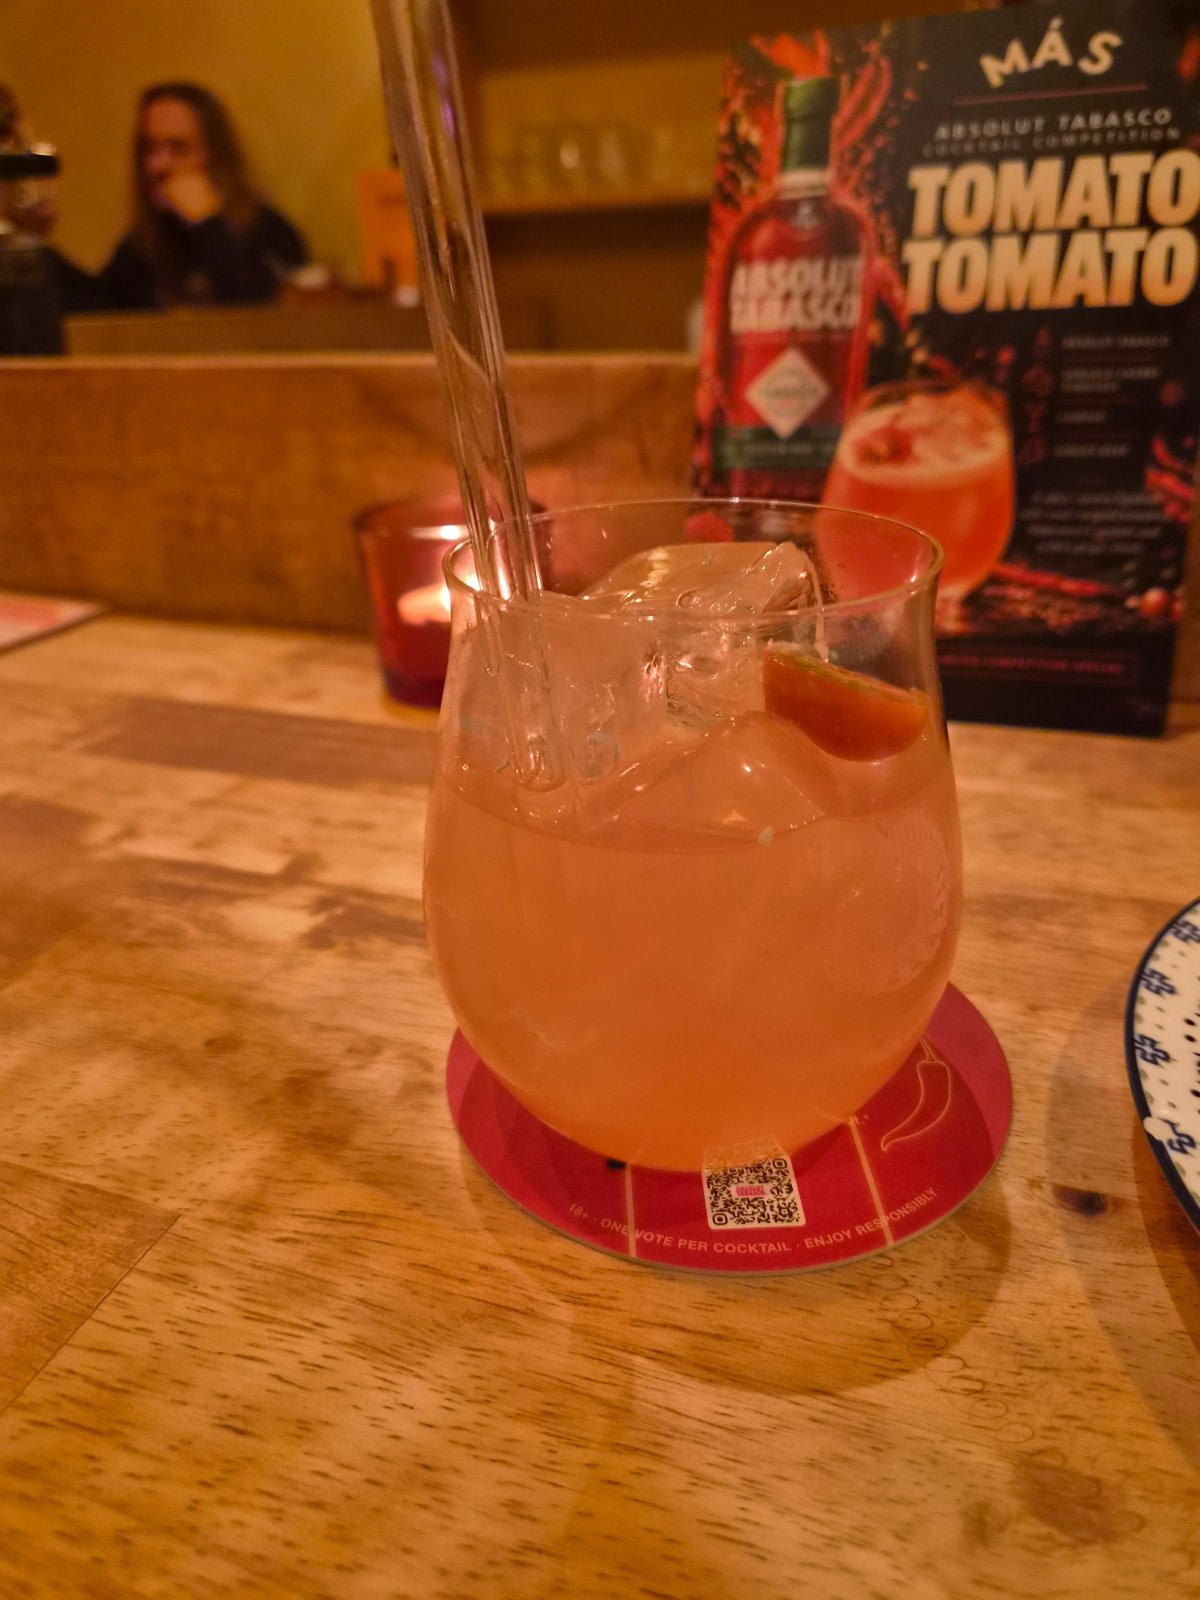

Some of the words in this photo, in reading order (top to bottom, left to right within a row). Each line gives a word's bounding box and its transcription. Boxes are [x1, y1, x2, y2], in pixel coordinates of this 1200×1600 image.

[980, 15, 1123, 89] MÁS
[934, 115, 1046, 141] ABSOLUT
[1057, 106, 1172, 132] TABASCO
[1032, 126, 1180, 150] COMPETITION
[908, 148, 1200, 238] TOMATO
[731, 256, 862, 302] ABSOLUT
[902, 227, 1198, 315] TOMATO
[568, 1203, 589, 1220] 18+
[600, 1218, 631, 1237] ONE
[633, 1229, 674, 1247] VOTE
[677, 1238, 708, 1252] PER
[713, 1242, 792, 1254] COCKTAIL
[804, 1228, 852, 1249] ENJOY
[855, 1187, 938, 1237] RESPONSIBLY
